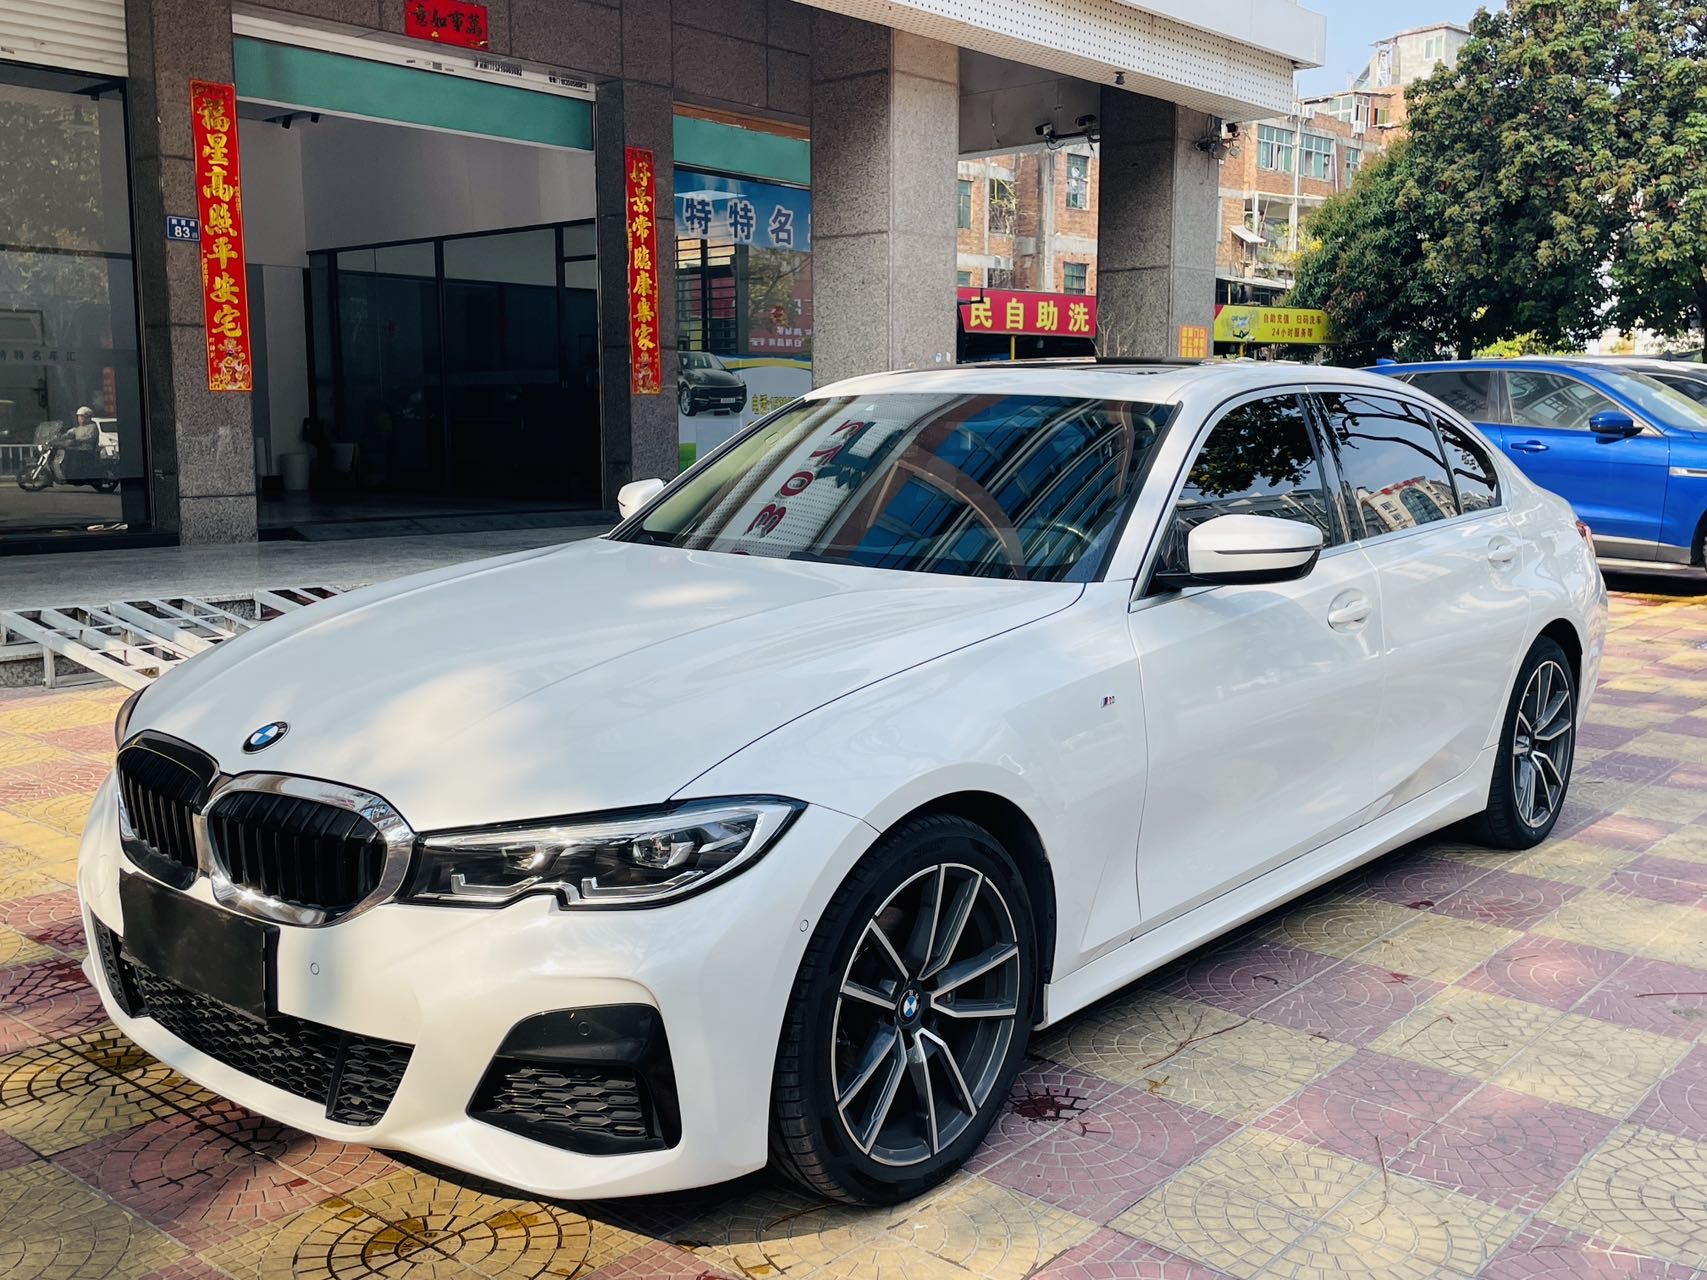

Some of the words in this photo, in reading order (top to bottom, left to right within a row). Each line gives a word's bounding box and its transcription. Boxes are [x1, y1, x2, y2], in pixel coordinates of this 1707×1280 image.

[197, 97, 242, 337] 福星高照平安宅
[683, 194, 811, 248] 特特名
[969, 296, 1090, 332] 民自助洗
